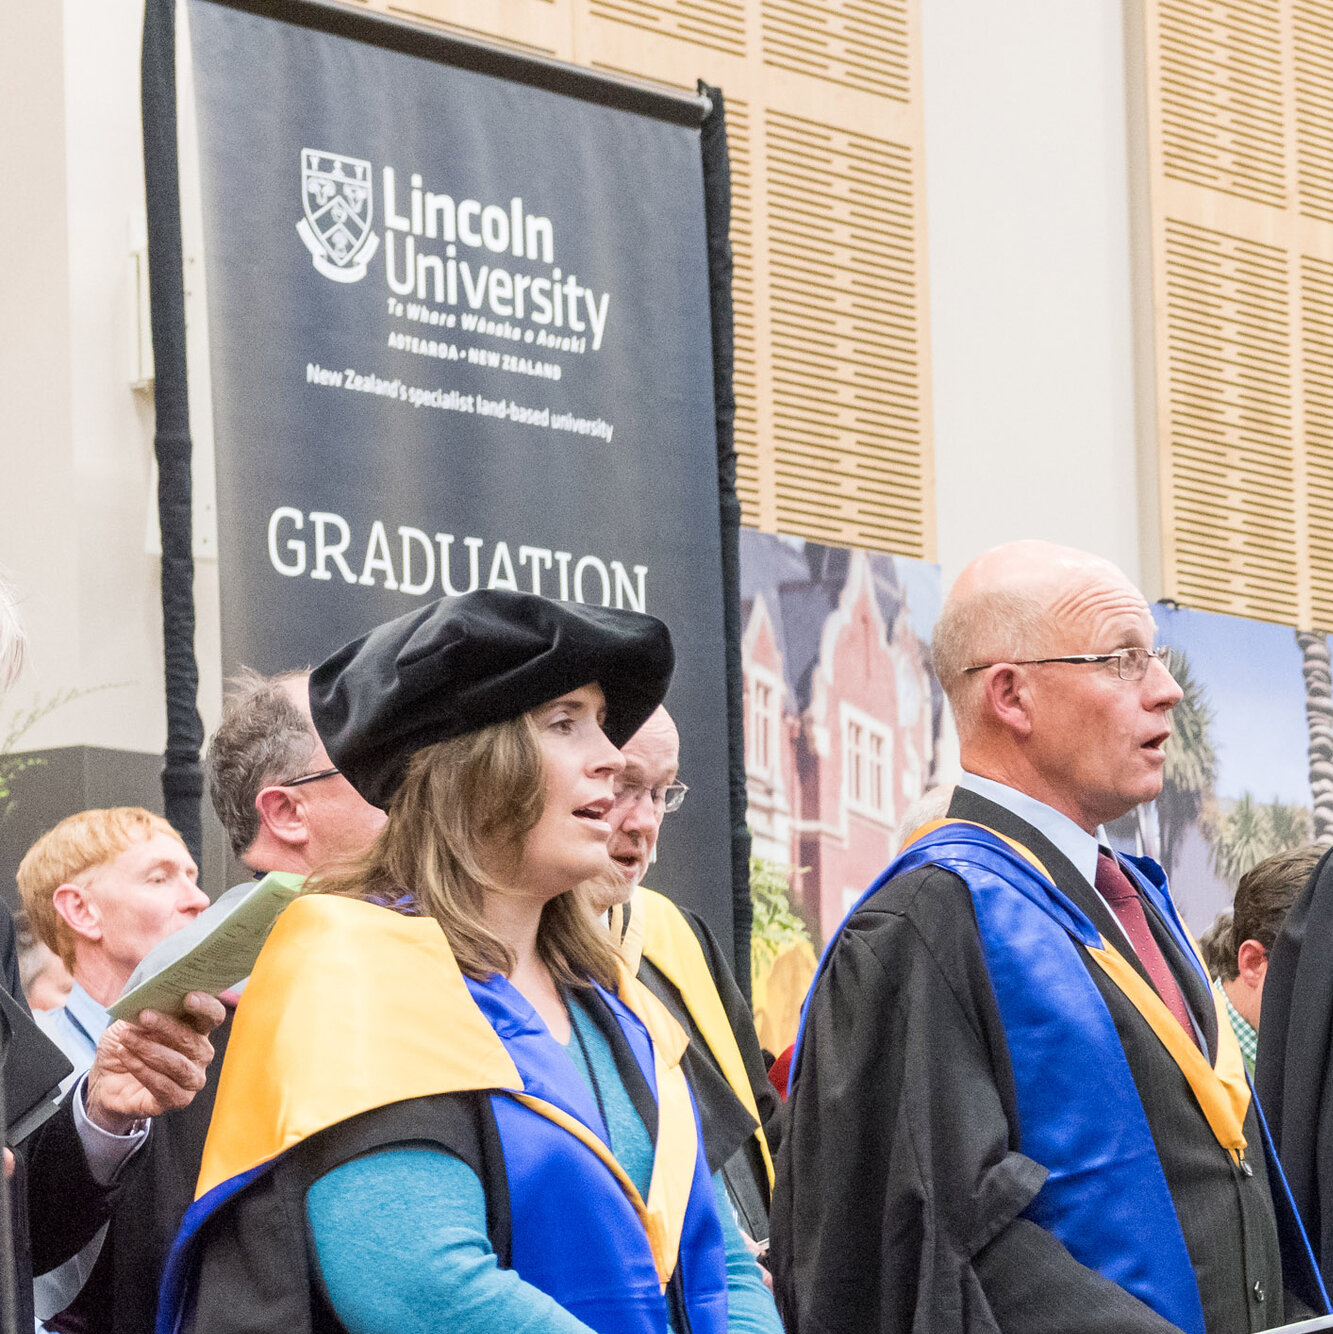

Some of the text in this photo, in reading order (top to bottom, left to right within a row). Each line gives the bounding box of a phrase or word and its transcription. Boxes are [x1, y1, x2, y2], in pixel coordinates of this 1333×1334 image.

[383, 165, 554, 263] Lincoln
[384, 229, 610, 350] University
[387, 297, 403, 317] Te
[406, 302, 456, 328] Whare
[524, 329, 534, 343] o
[536, 329, 586, 354] Aoraki
[306, 362, 614, 443] New Zealand's specialist land-based university
[502, 353, 562, 381] ZEALAND
[267, 506, 649, 615] GRADUATION
